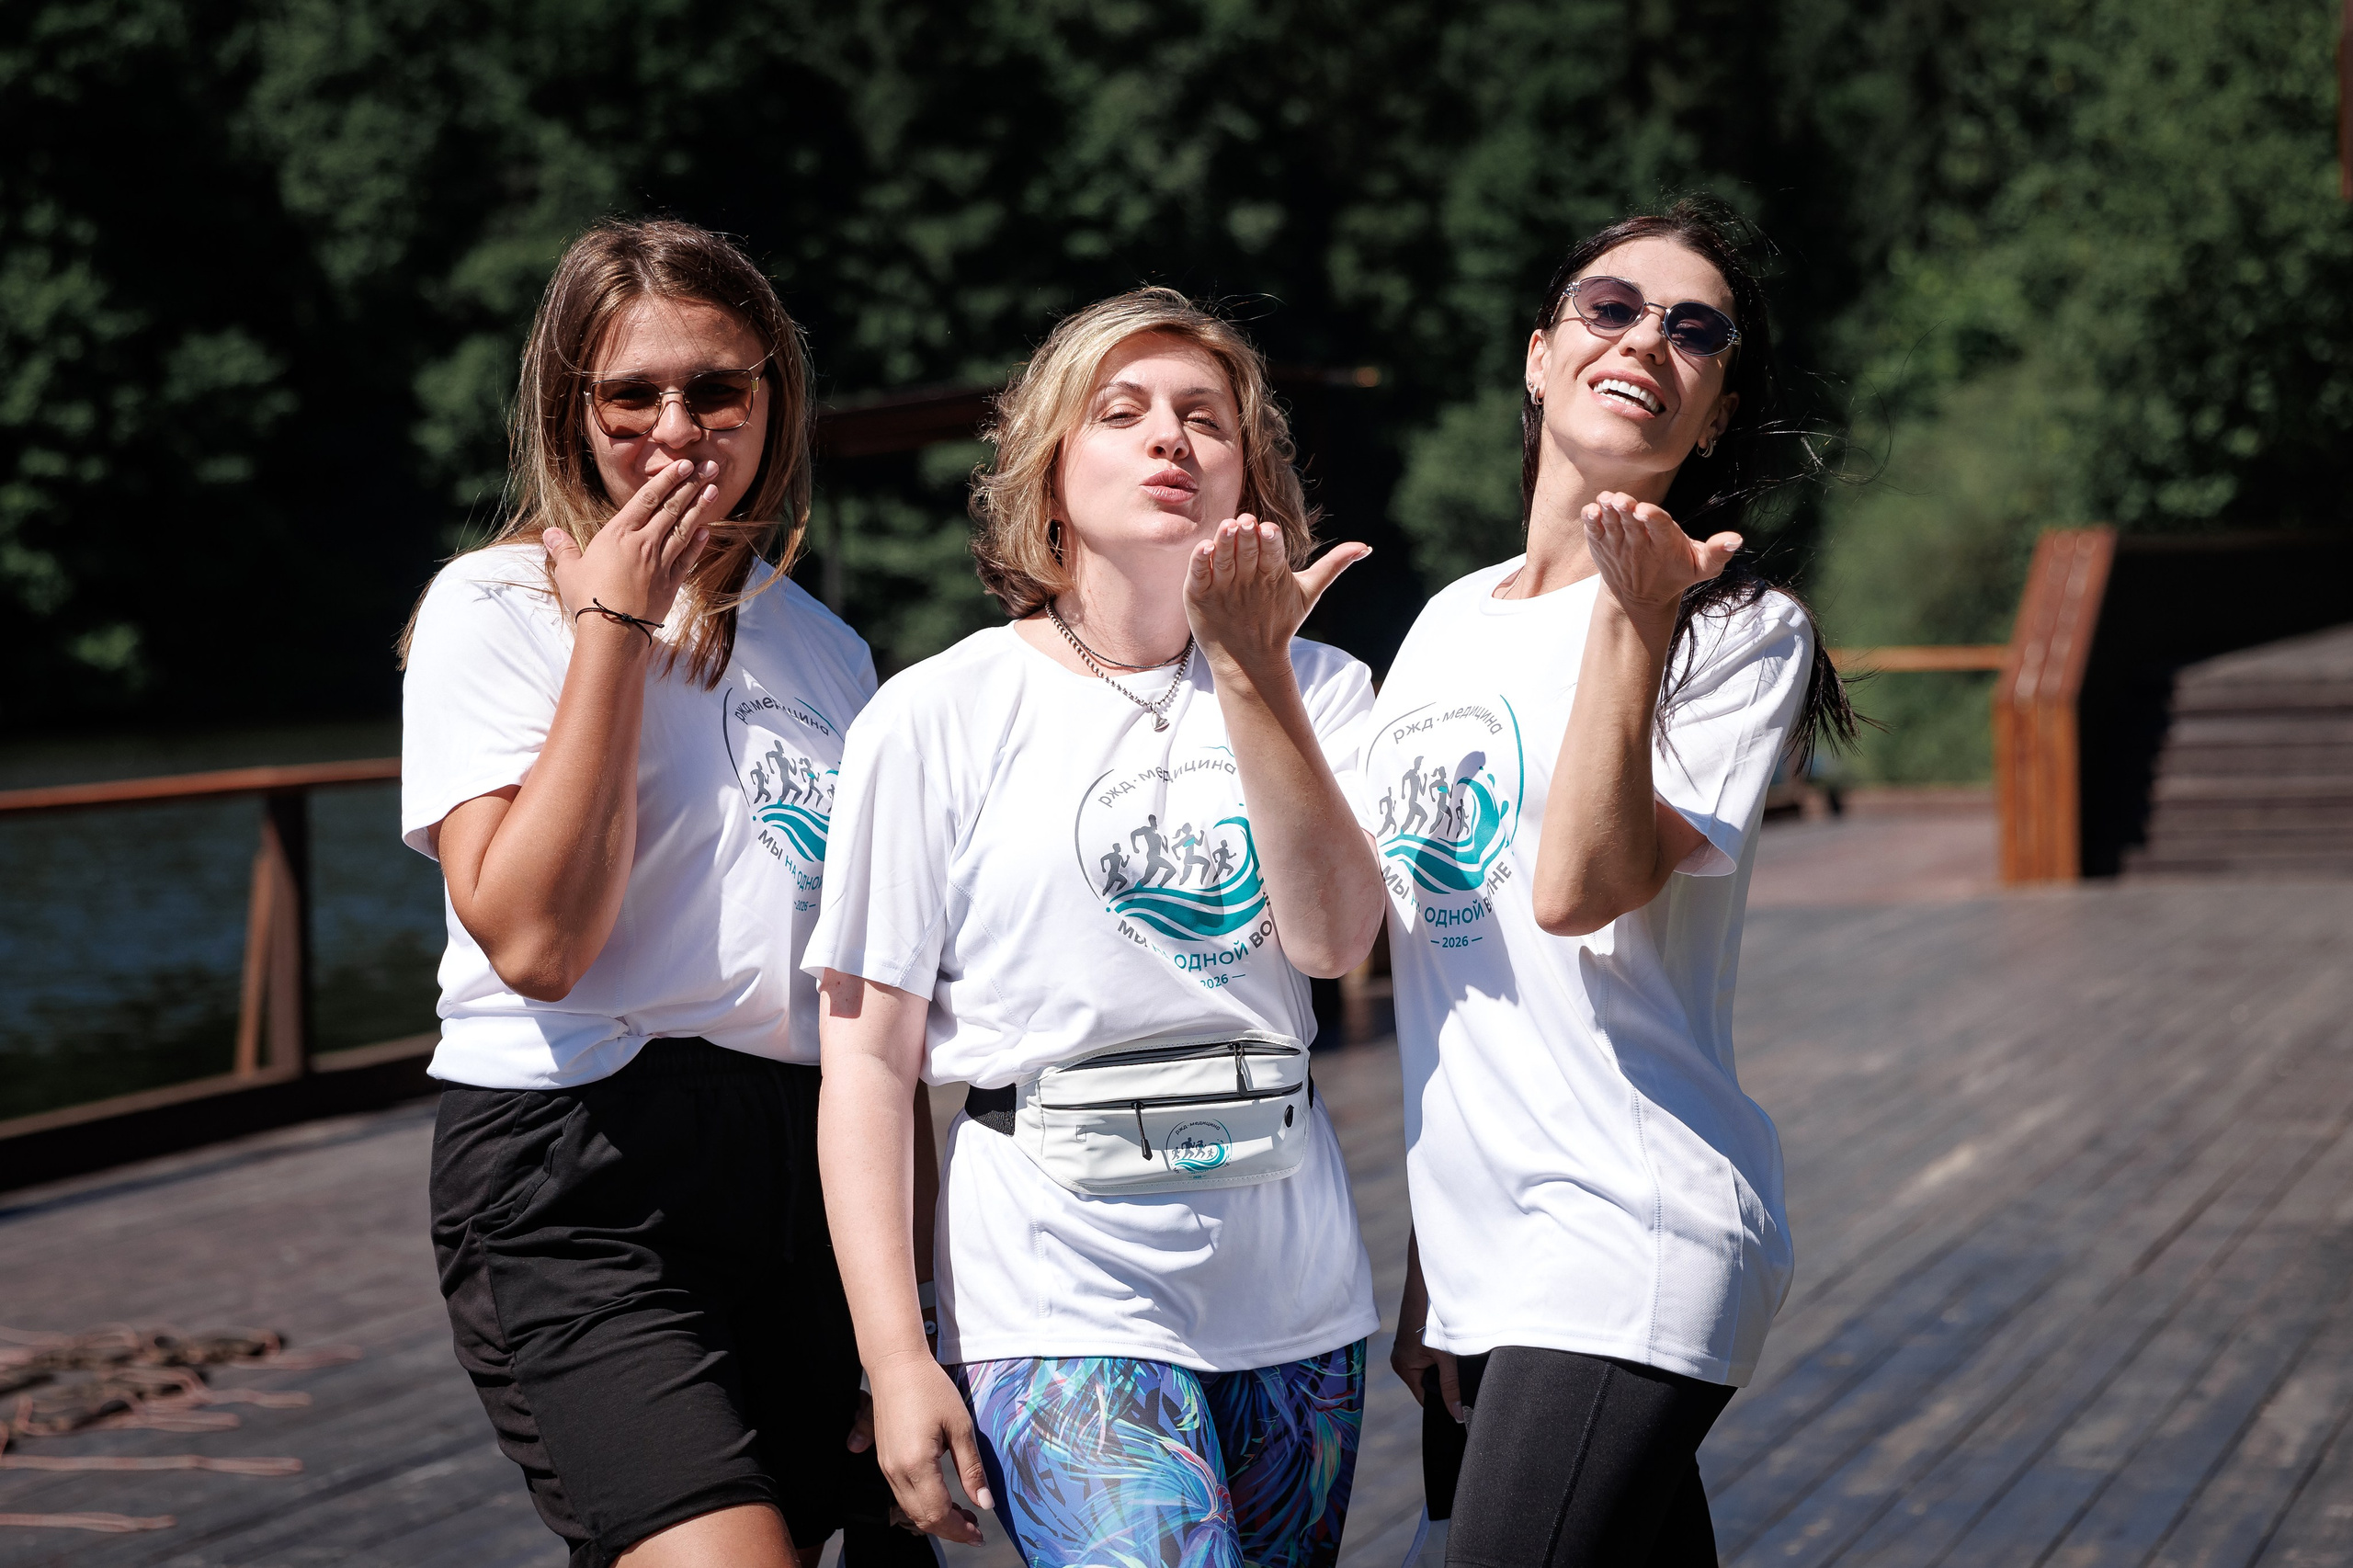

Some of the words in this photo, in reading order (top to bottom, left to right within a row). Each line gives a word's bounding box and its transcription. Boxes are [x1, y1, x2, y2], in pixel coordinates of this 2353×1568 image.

[757, 829, 783, 860] МЫ
[785, 855, 797, 879] НА
[1381, 865, 1410, 900] МЫ
[1425, 899, 1485, 928] ОДНОЙ
[1174, 939, 1249, 972] ОДНОЙ
[1441, 936, 1469, 949] 2026
